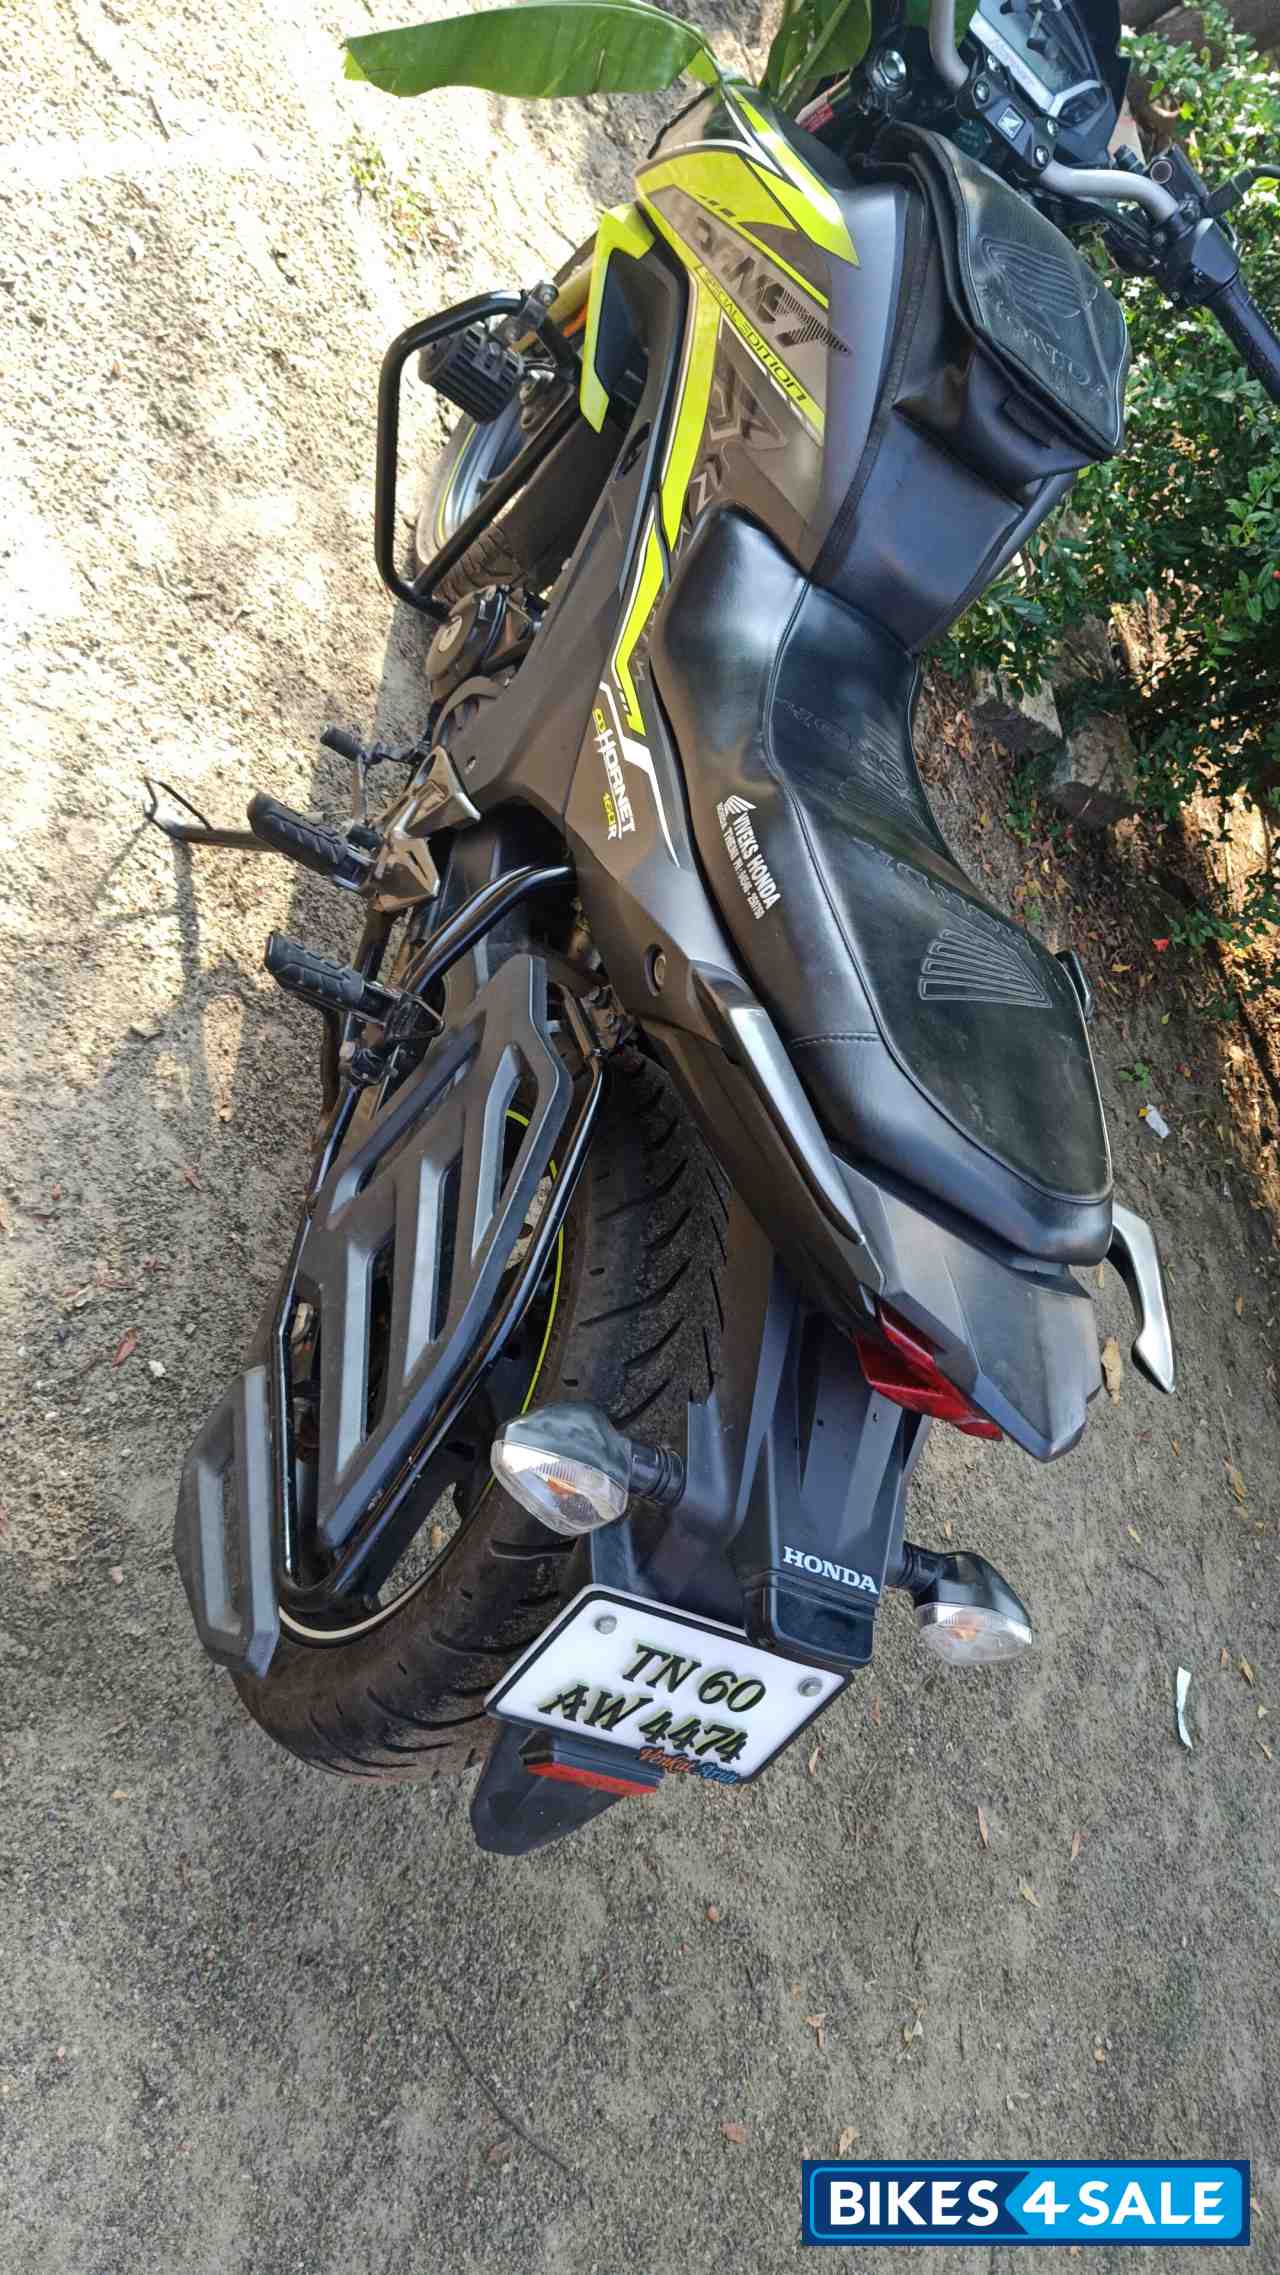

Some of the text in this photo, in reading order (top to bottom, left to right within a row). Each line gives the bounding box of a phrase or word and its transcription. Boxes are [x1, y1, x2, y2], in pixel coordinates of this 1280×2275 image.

[594, 728, 636, 832] HORNET
[733, 811, 759, 860] VIVEKS
[747, 853, 781, 910] HONDA
[783, 1546, 879, 1595] HONDA
[622, 1643, 766, 1713] TN 60
[537, 1684, 748, 1764] AW 4474
